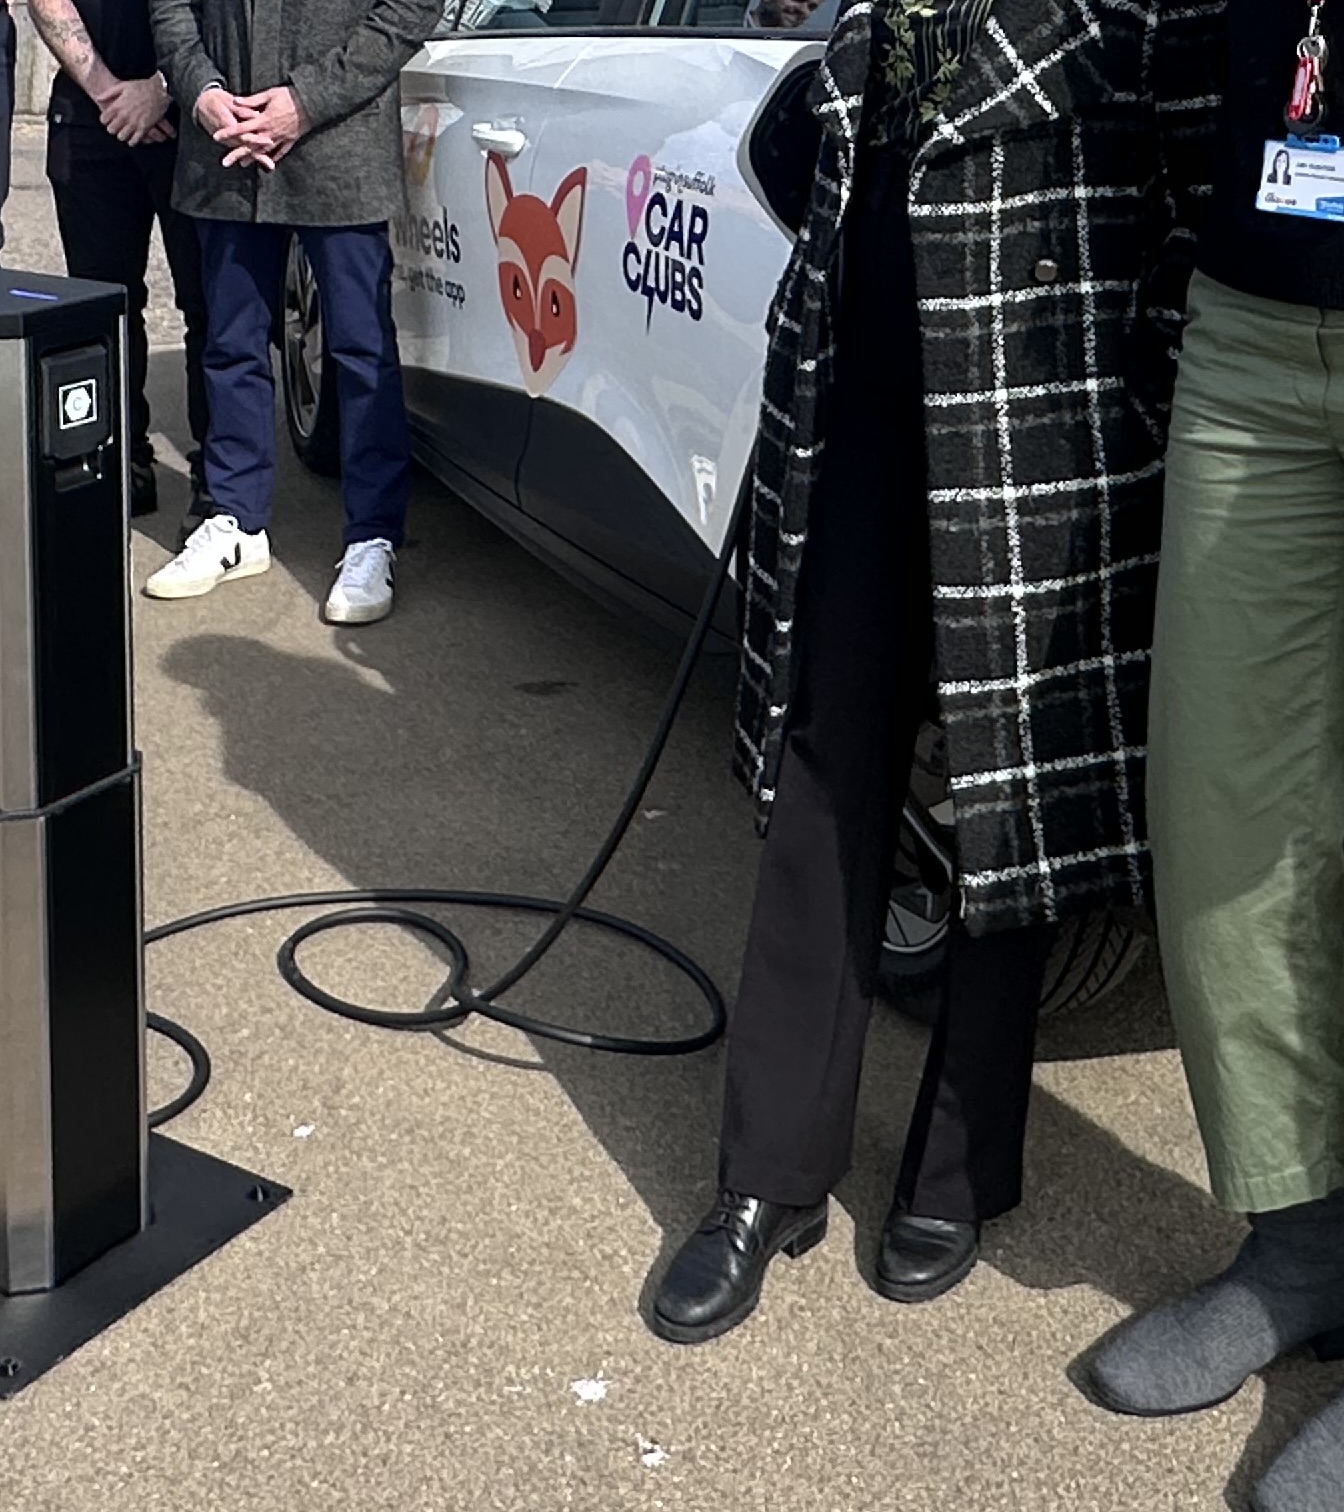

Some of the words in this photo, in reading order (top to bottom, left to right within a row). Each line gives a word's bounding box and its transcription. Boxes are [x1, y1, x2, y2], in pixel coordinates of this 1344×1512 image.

[644, 192, 709, 266] CAR
[445, 280, 465, 309] app
[623, 241, 704, 333] CLUBS
